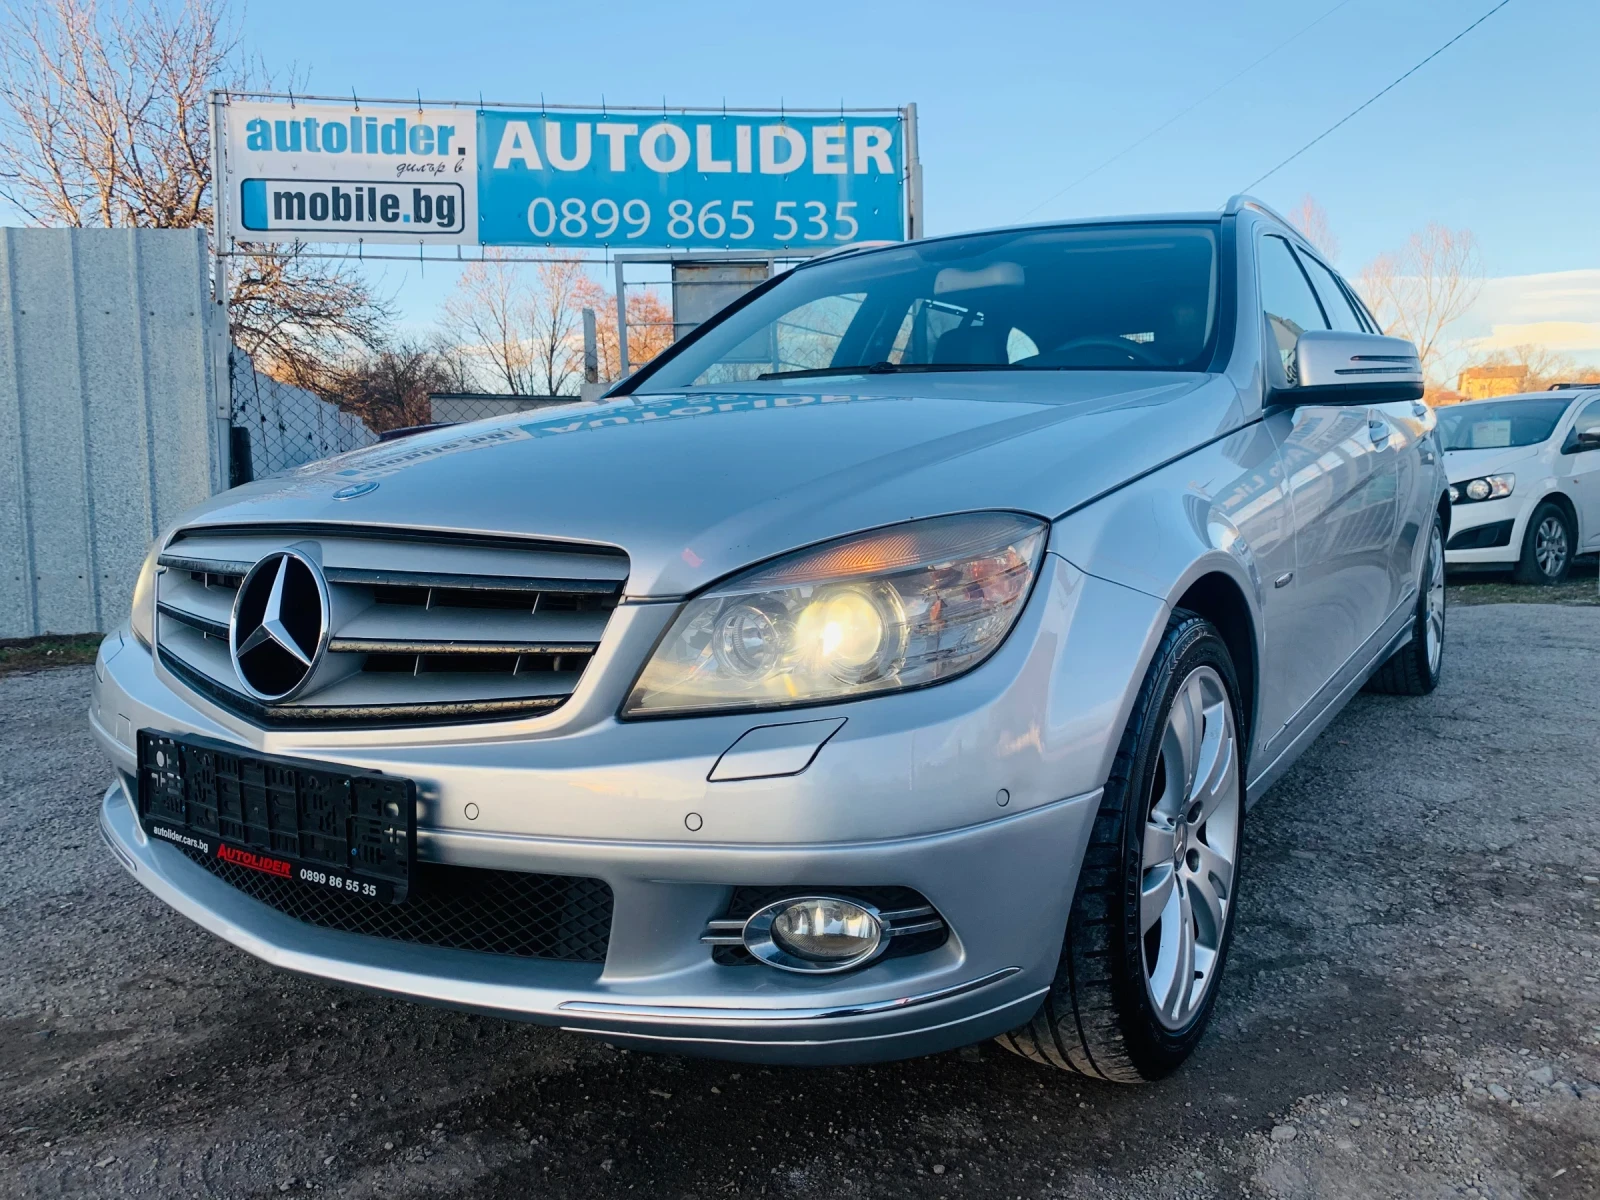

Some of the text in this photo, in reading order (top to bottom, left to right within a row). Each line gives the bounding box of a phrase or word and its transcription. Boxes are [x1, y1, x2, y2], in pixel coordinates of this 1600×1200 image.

[493, 120, 895, 175] AUTOLIDER
[396, 161, 446, 178] дилър
[273, 186, 455, 228] mobile.bg
[527, 197, 858, 241] 0899 865 535
[153, 825, 209, 853] autolider.cars.bg
[217, 843, 292, 875] AUTOLIDER
[300, 868, 376, 896] 0899 86 55 35
